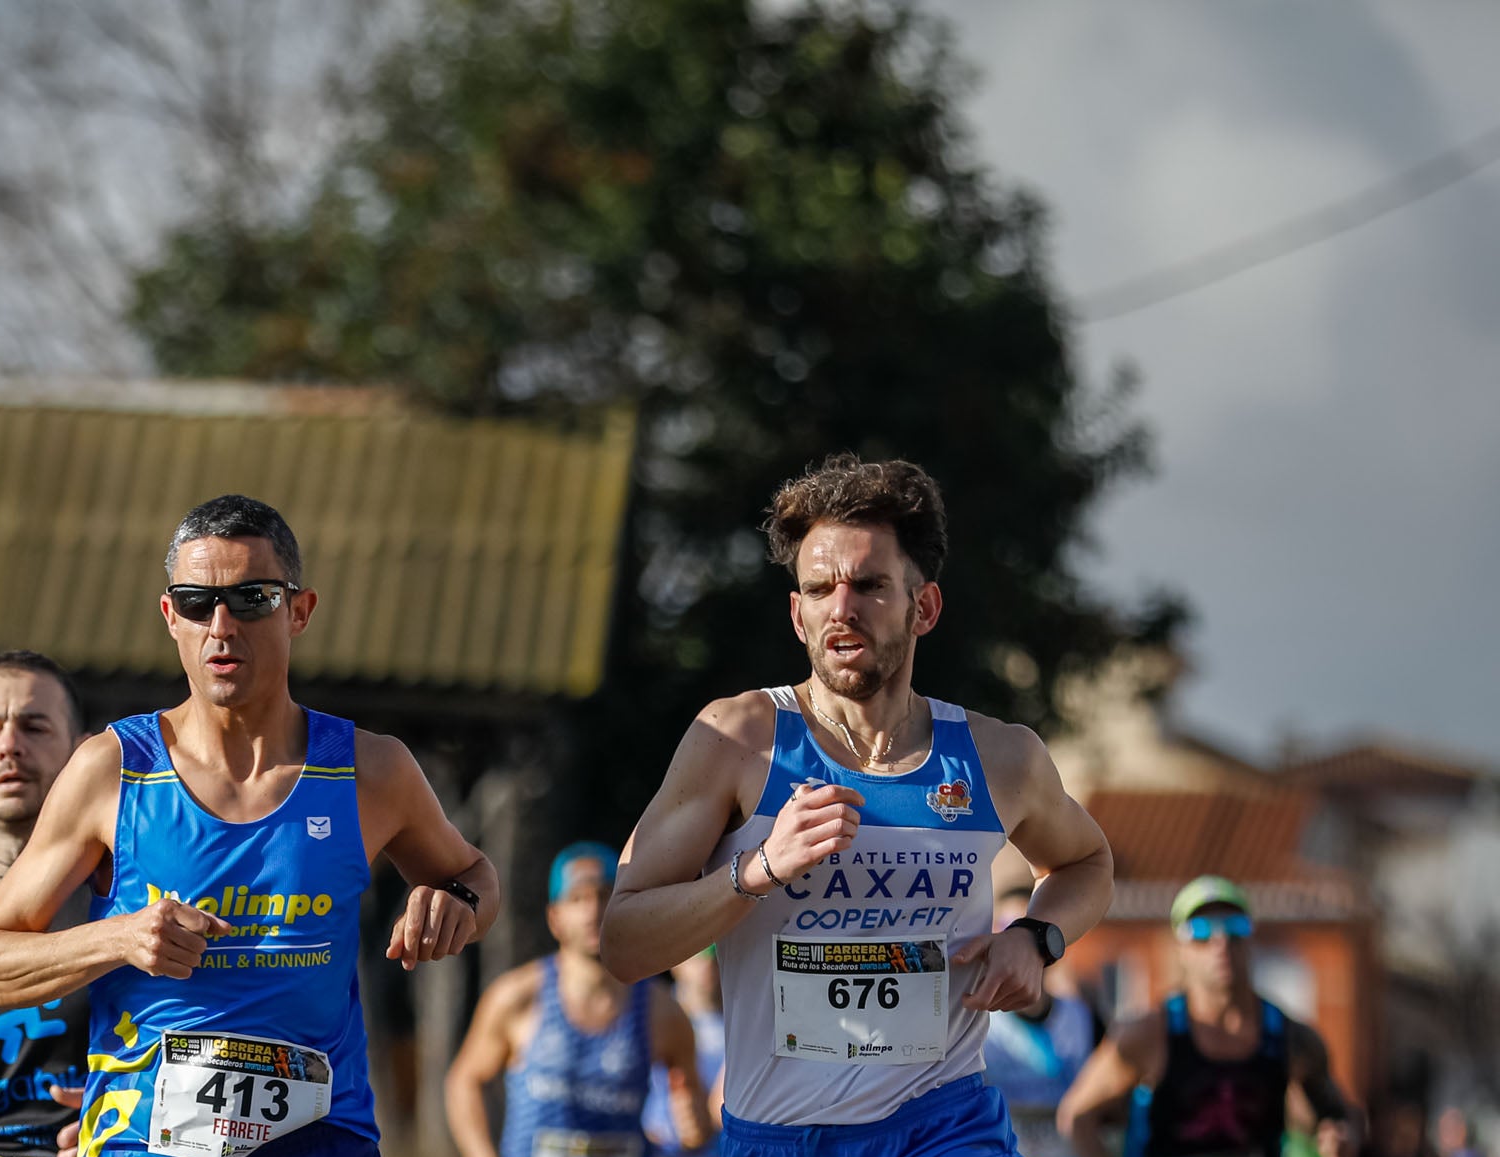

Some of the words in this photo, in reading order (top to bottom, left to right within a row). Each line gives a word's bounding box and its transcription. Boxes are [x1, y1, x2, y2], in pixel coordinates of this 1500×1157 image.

[852, 852, 978, 865] ATLETISMO
[784, 868, 974, 900] CAXAR
[195, 885, 333, 924] olimpo
[782, 944, 798, 956] 26
[824, 945, 887, 955] CARRERA
[824, 954, 886, 963] POPULAR
[237, 954, 250, 968] &
[254, 950, 332, 968] RUNNING
[782, 960, 798, 969] Ruta
[809, 961, 820, 970] los
[821, 962, 859, 971] Secaderos
[828, 977, 900, 1010] 676
[171, 1038, 188, 1049] 26
[213, 1039, 273, 1056] CARRERA
[859, 1042, 894, 1054] olimpo
[171, 1052, 188, 1062] Ruta
[207, 1056, 244, 1069] Secaderos
[212, 1048, 272, 1064] POPULAR
[195, 1072, 290, 1122] 413
[213, 1117, 273, 1142] FERRETE
